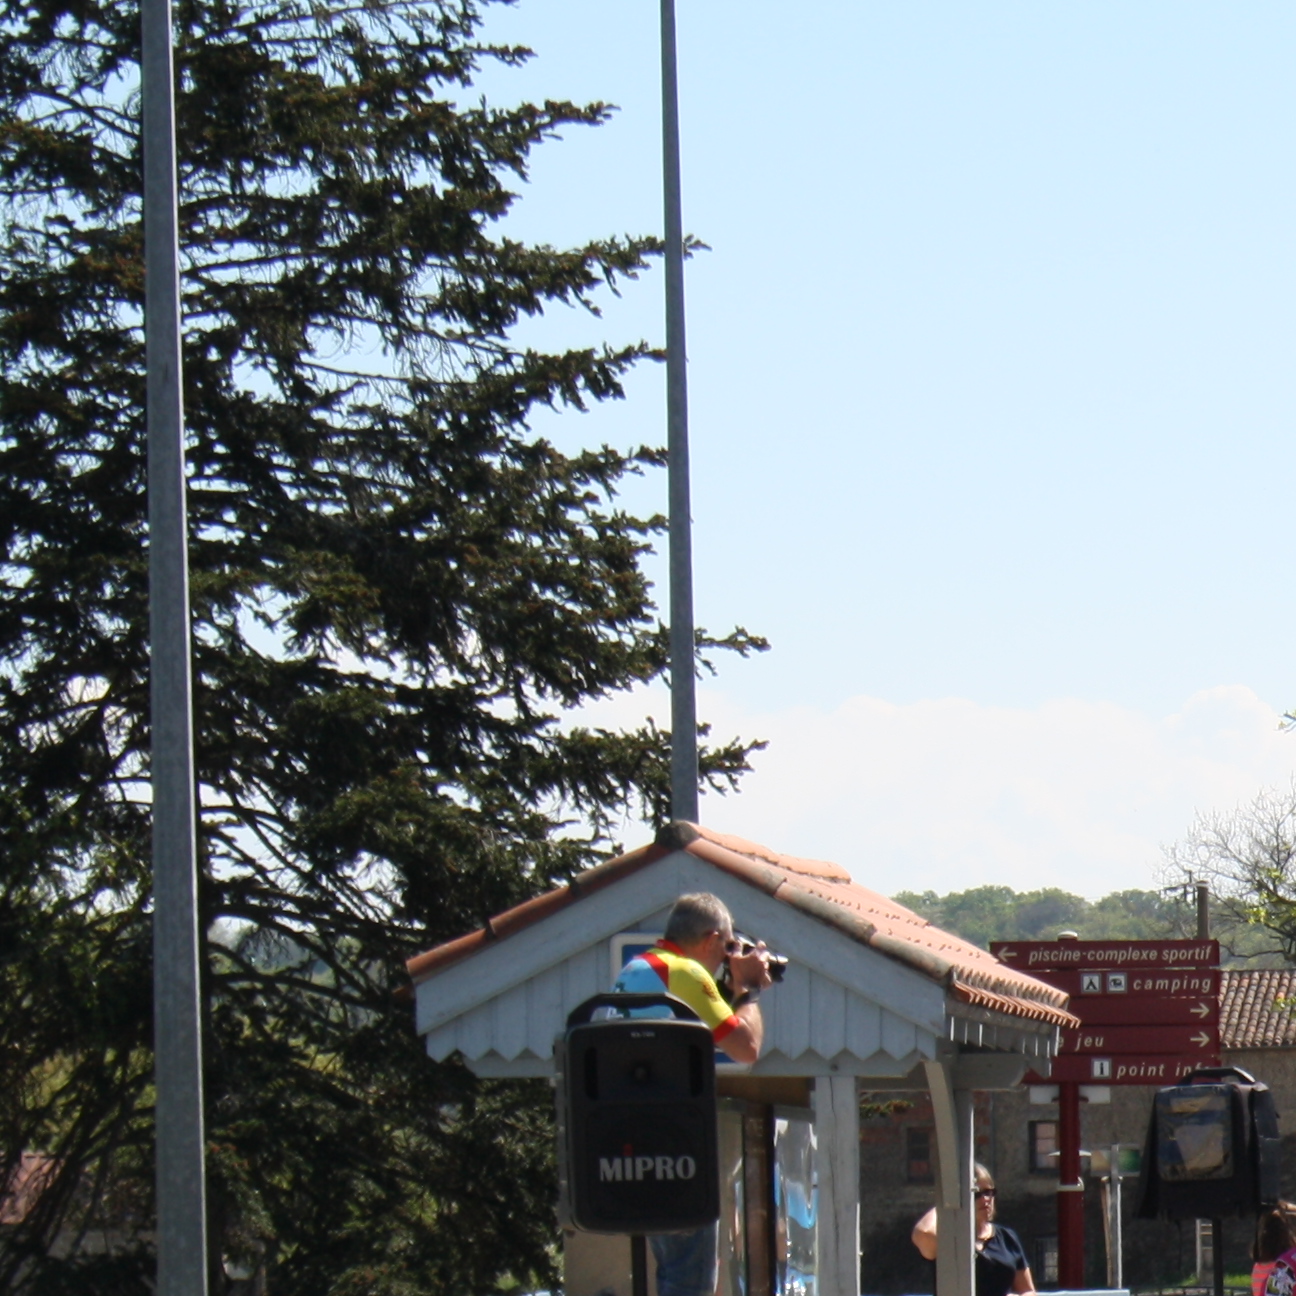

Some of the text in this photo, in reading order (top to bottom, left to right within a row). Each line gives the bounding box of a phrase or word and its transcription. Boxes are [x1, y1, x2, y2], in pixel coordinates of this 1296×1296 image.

[1029, 946, 1212, 965] piscine-complexe sportif
[1133, 976, 1212, 993] camping
[1075, 1033, 1104, 1050] jeu
[1117, 1061, 1210, 1079] point inf
[600, 1144, 696, 1182] MIPRO
